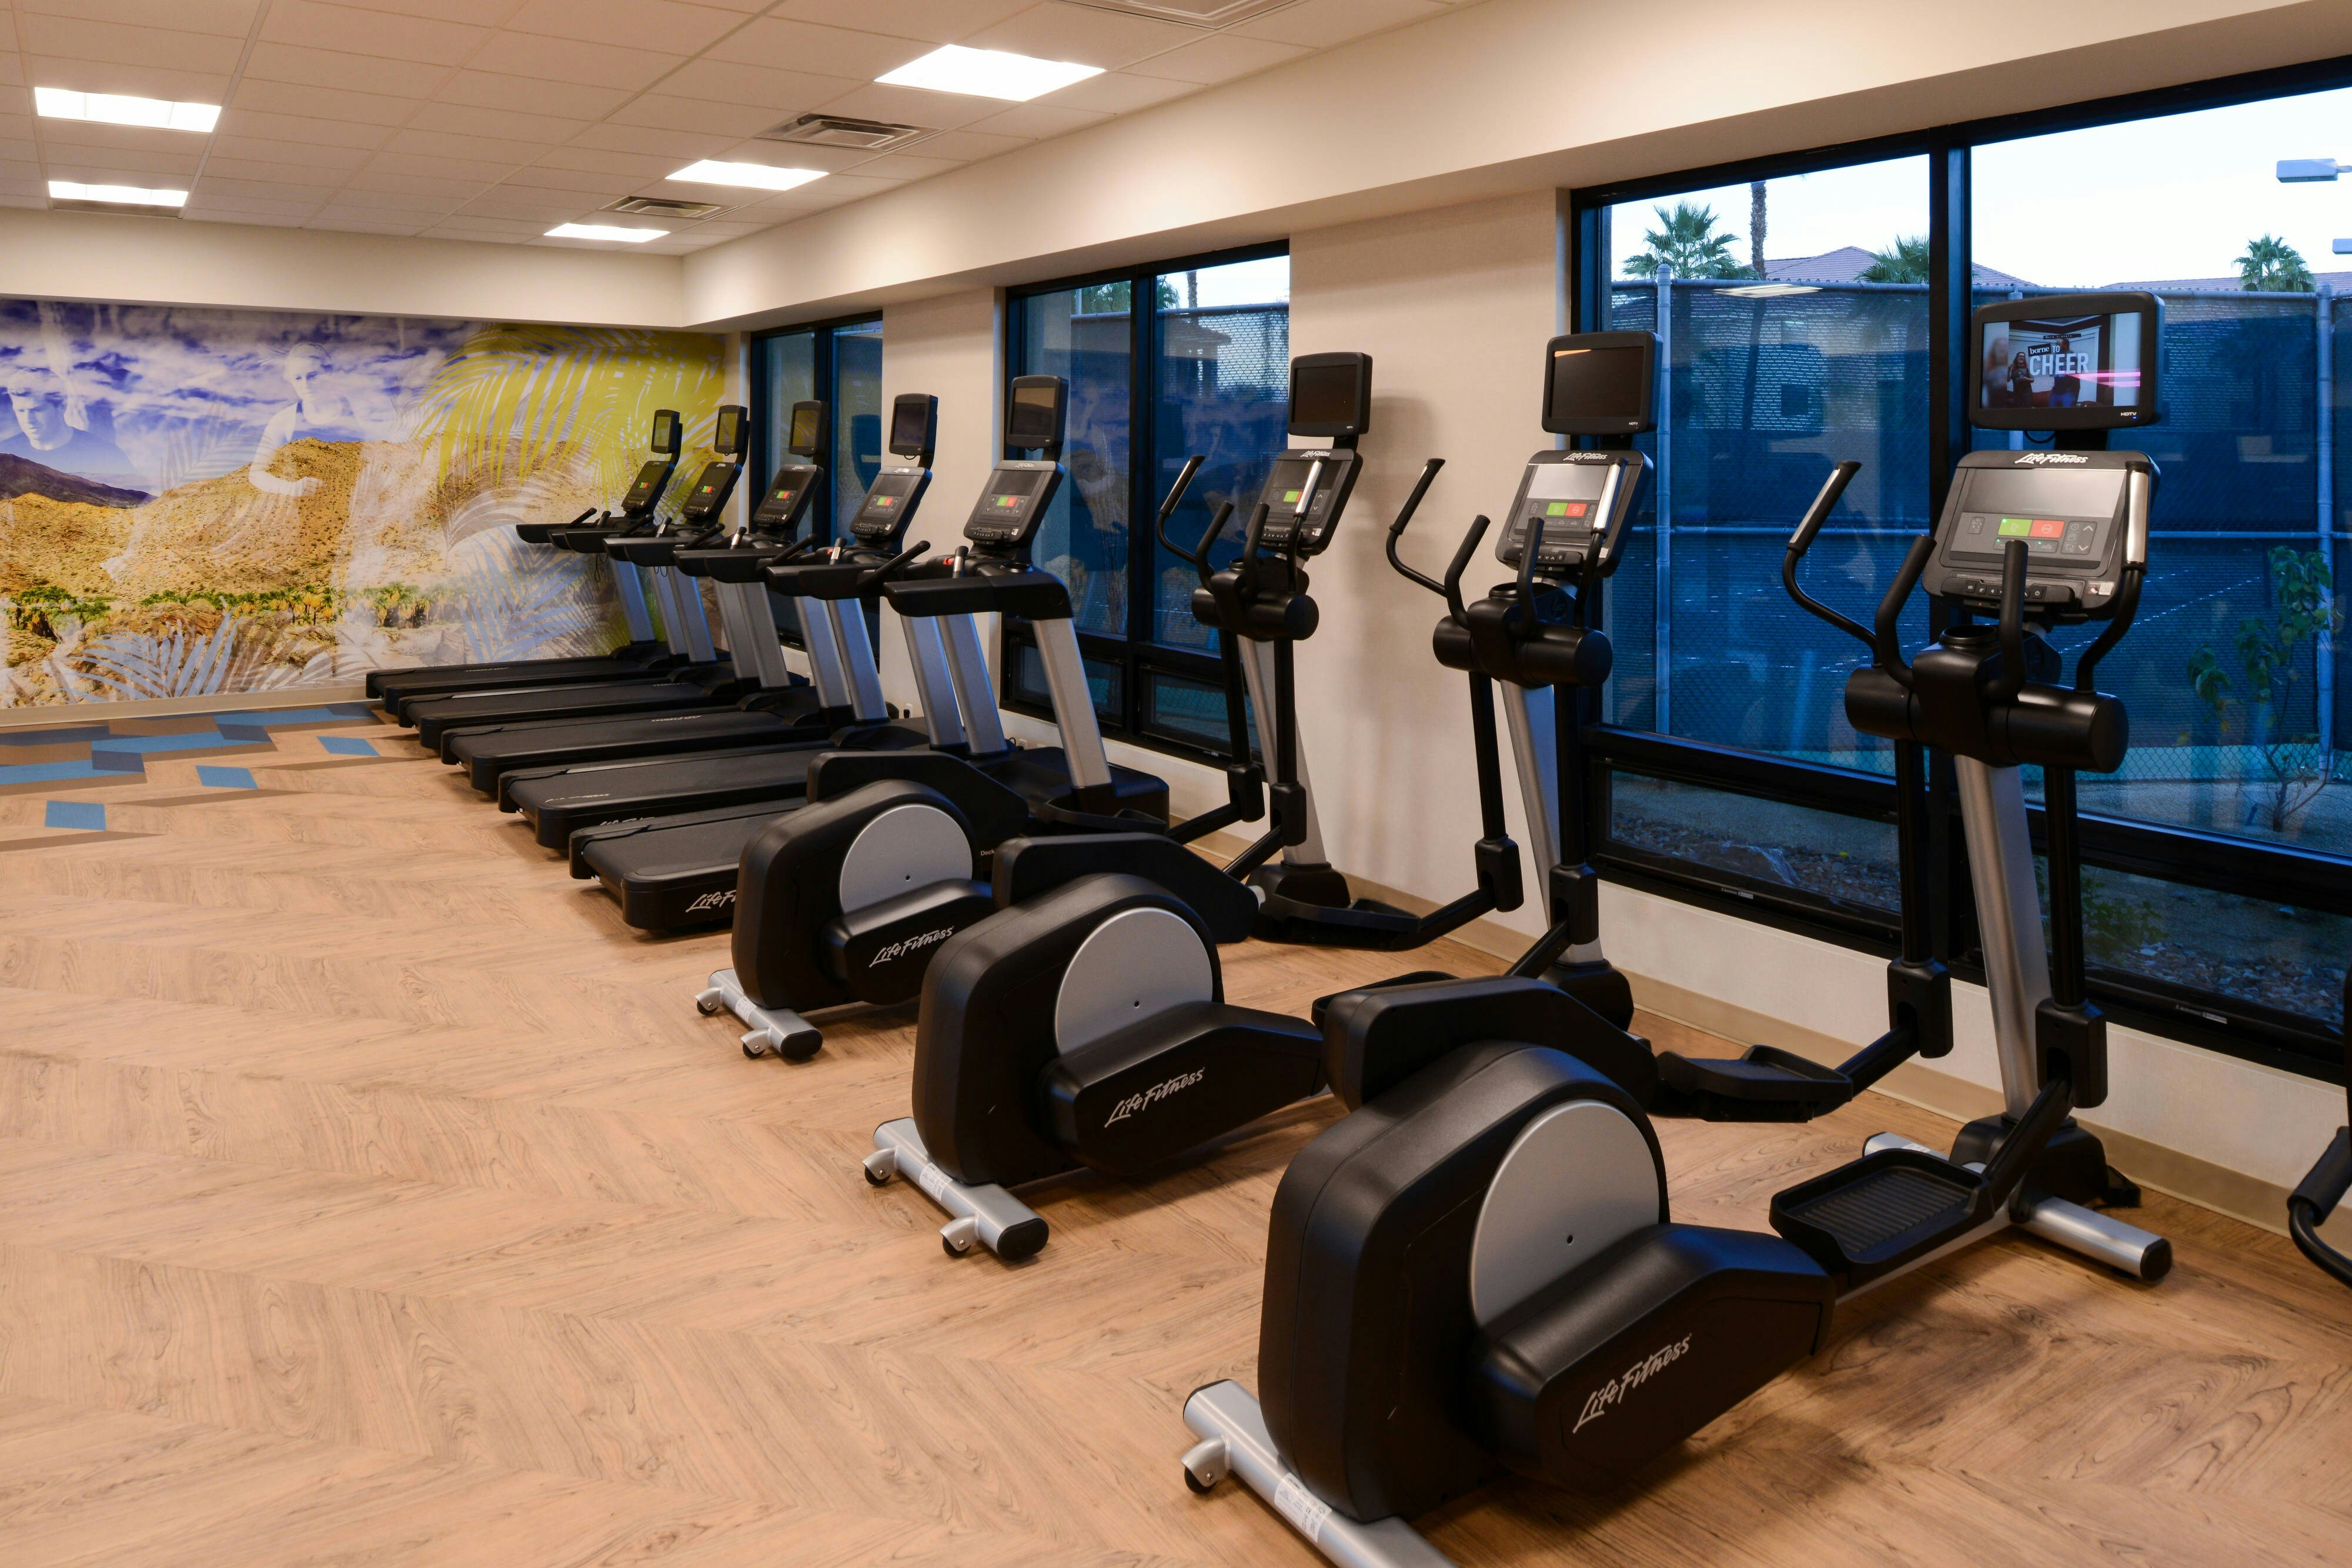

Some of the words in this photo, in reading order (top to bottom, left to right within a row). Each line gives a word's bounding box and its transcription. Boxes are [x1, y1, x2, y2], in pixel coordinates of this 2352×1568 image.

[2030, 346, 2050, 355] borne
[2029, 353, 2089, 376] CHEER
[2014, 453, 2044, 464] Life
[2039, 453, 2089, 464] Fitness
[685, 891, 722, 912] Life
[868, 942, 901, 968] Life
[900, 927, 953, 957] Fitness
[1104, 1093, 1143, 1128] Life
[1142, 1068, 1204, 1111] Fitness
[1572, 1379, 1619, 1435] Life
[1617, 1336, 1691, 1404] Fitness
